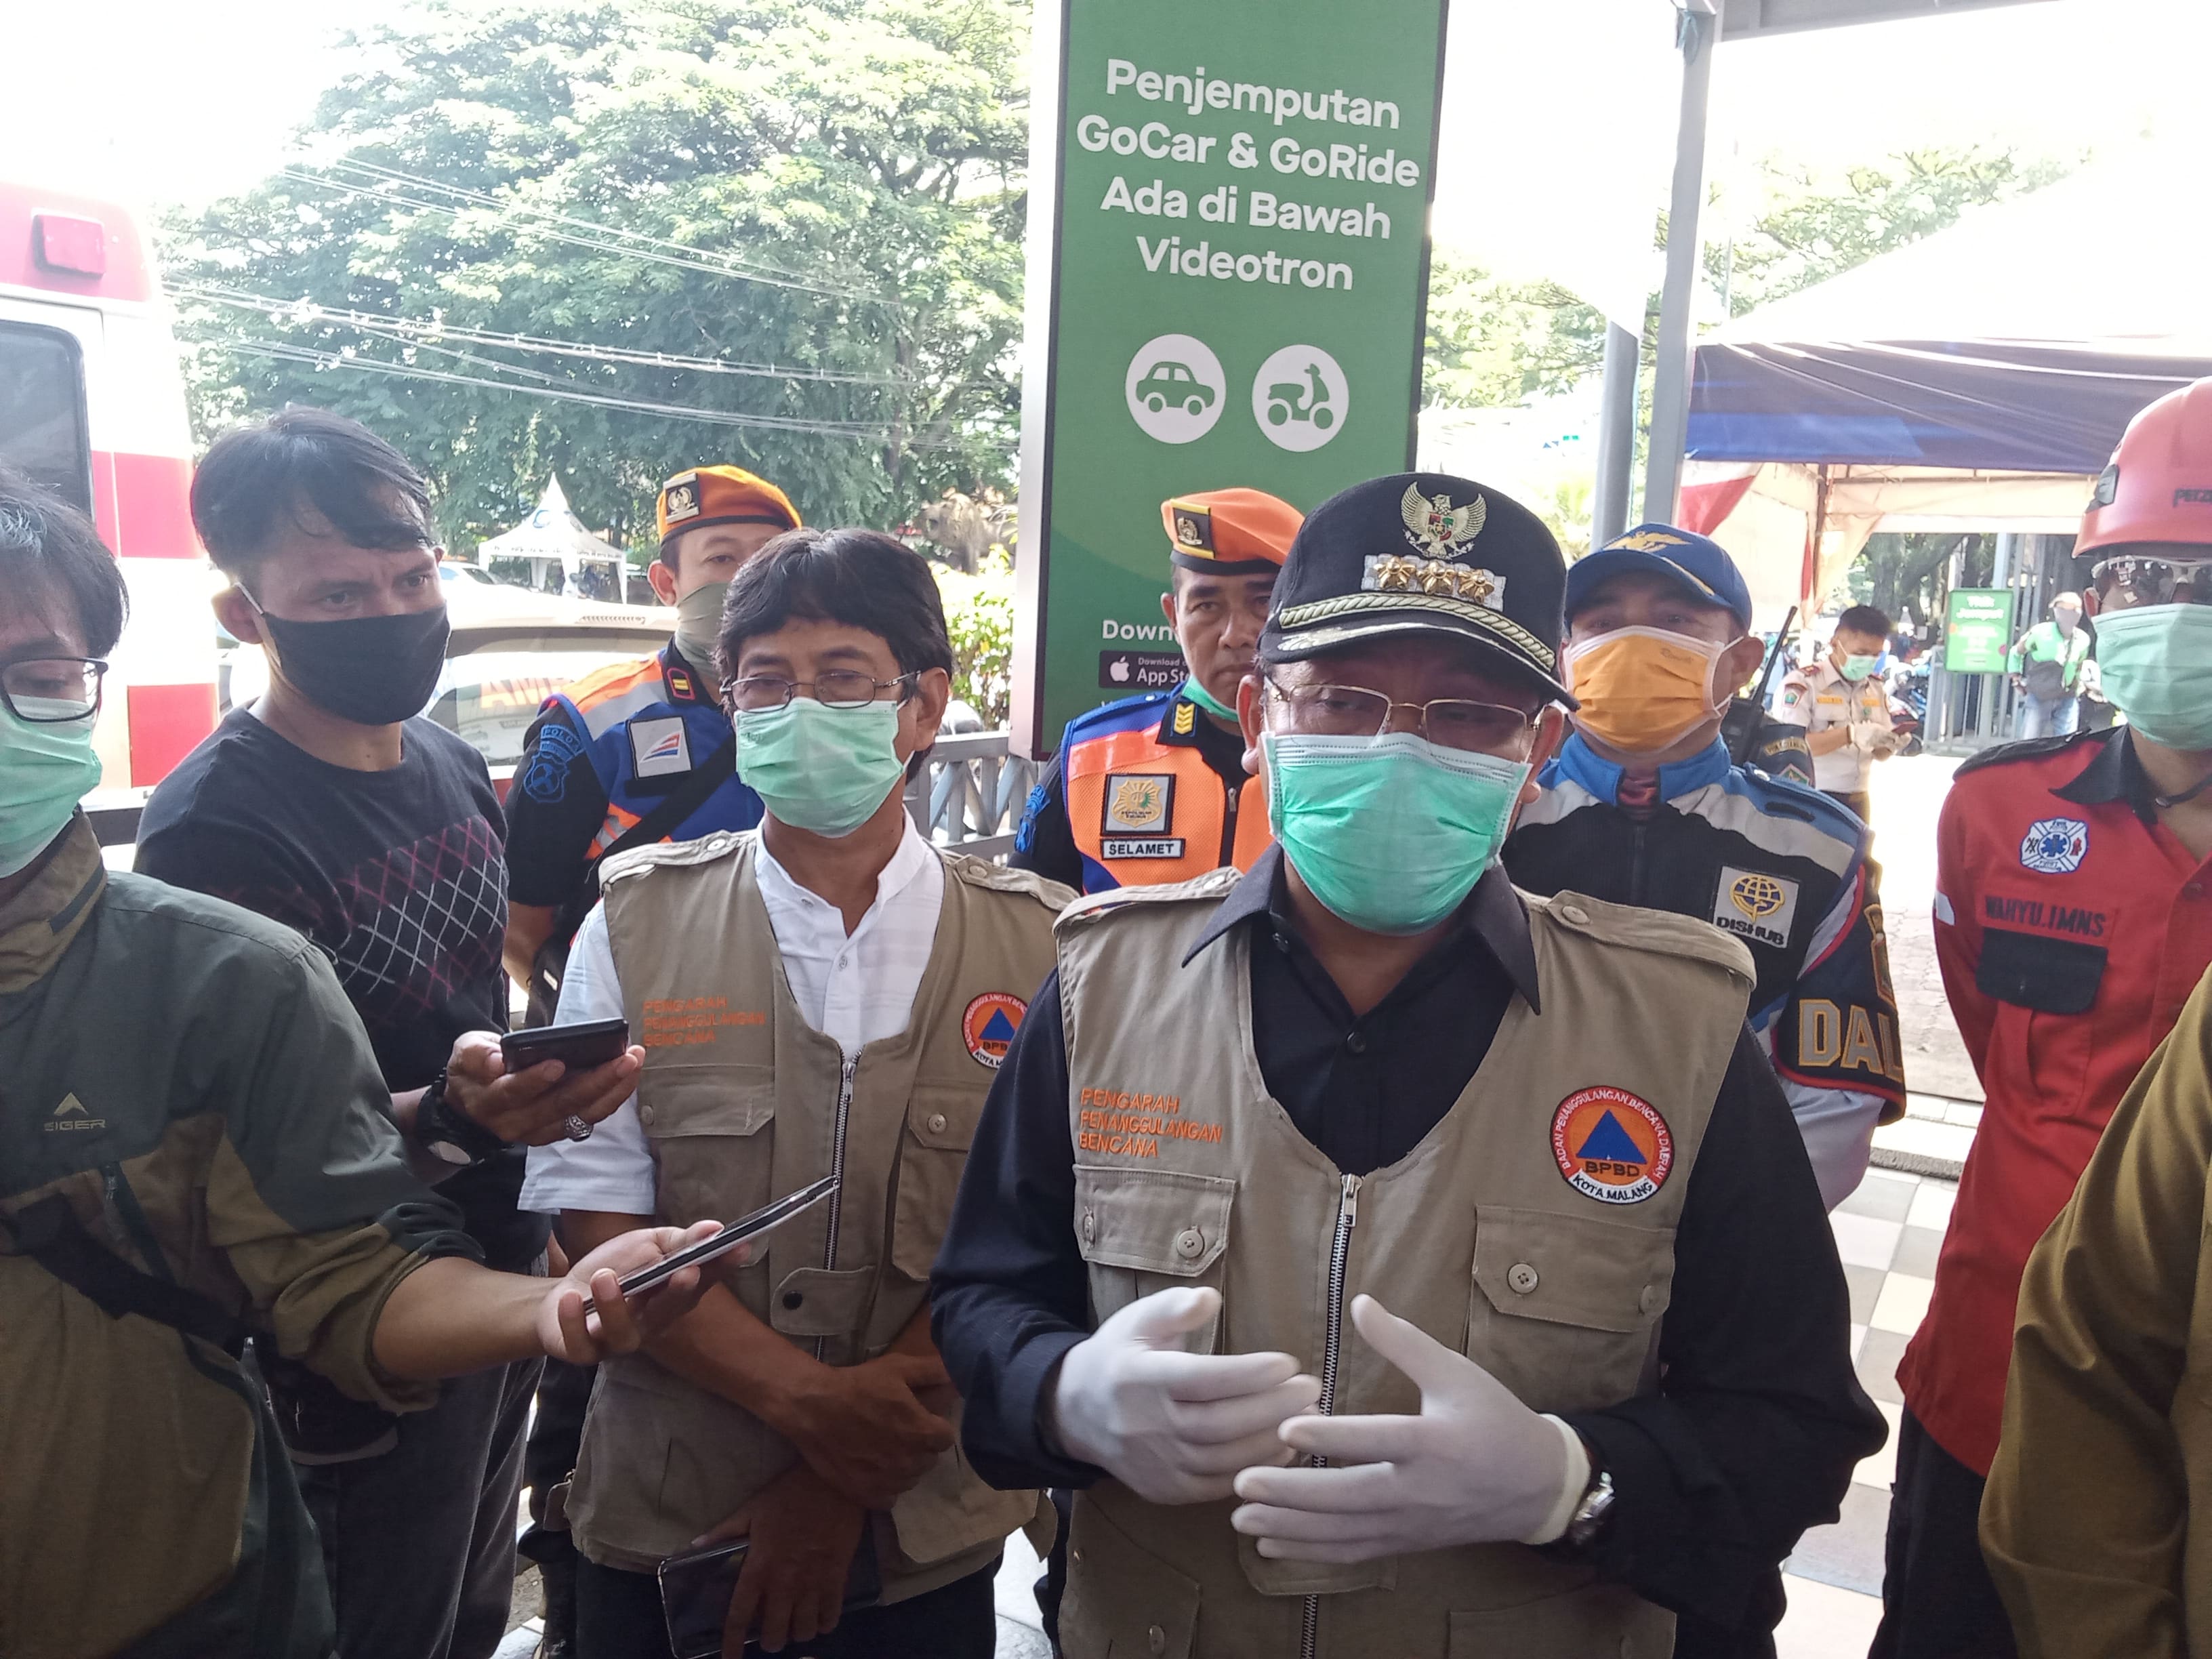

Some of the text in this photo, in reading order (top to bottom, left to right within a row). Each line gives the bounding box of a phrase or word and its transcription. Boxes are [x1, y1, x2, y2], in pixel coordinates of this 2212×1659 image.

[1106, 58, 1399, 129] Penjemputan
[1076, 114, 1420, 186] GoCar & GoRide
[1100, 176, 1391, 239] Ada di Bawah
[1136, 236, 1353, 290] Videotron
[1138, 657, 1180, 667] Download
[1136, 668, 1168, 687] App
[1109, 843, 1174, 855] SELAMET
[1716, 917, 1784, 945] DISHUB
[1080, 1088, 1180, 1114] PENGARAH
[44, 1119, 106, 1131] EIGER
[1080, 1110, 1223, 1143] PENANGGULANGAN
[1555, 1090, 1671, 1180] BADAN PENANGGULANGAN BENCANA DAERAH
[1078, 1132, 1159, 1158] BENCANA
[1585, 1161, 1639, 1176] BPBD
[1572, 1174, 1653, 1200] KOTA MALANG
